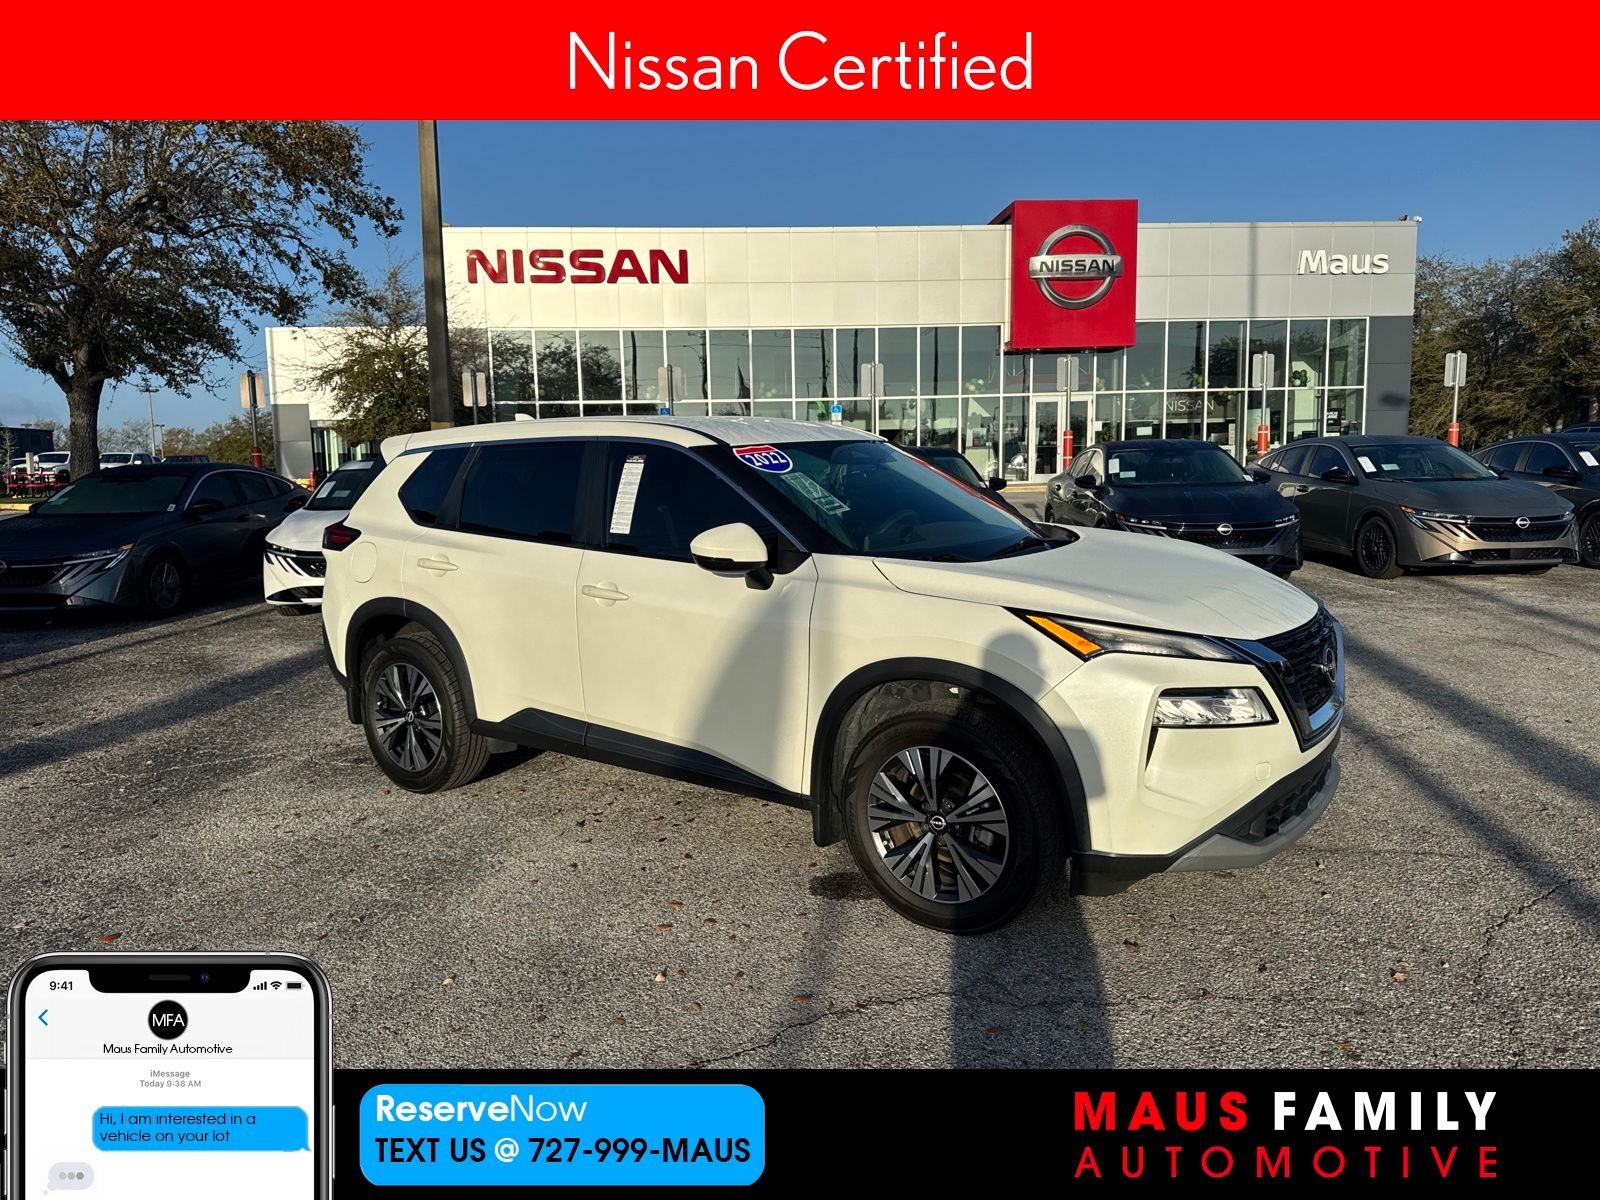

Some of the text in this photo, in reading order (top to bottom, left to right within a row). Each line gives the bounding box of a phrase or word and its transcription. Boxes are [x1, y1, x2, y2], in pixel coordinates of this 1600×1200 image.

[466, 249, 689, 284] NISSAN
[1039, 259, 1115, 273] NISSAN
[1297, 249, 1389, 275] Maus
[1165, 399, 1215, 411] NISSAN
[745, 451, 787, 467] 2022
